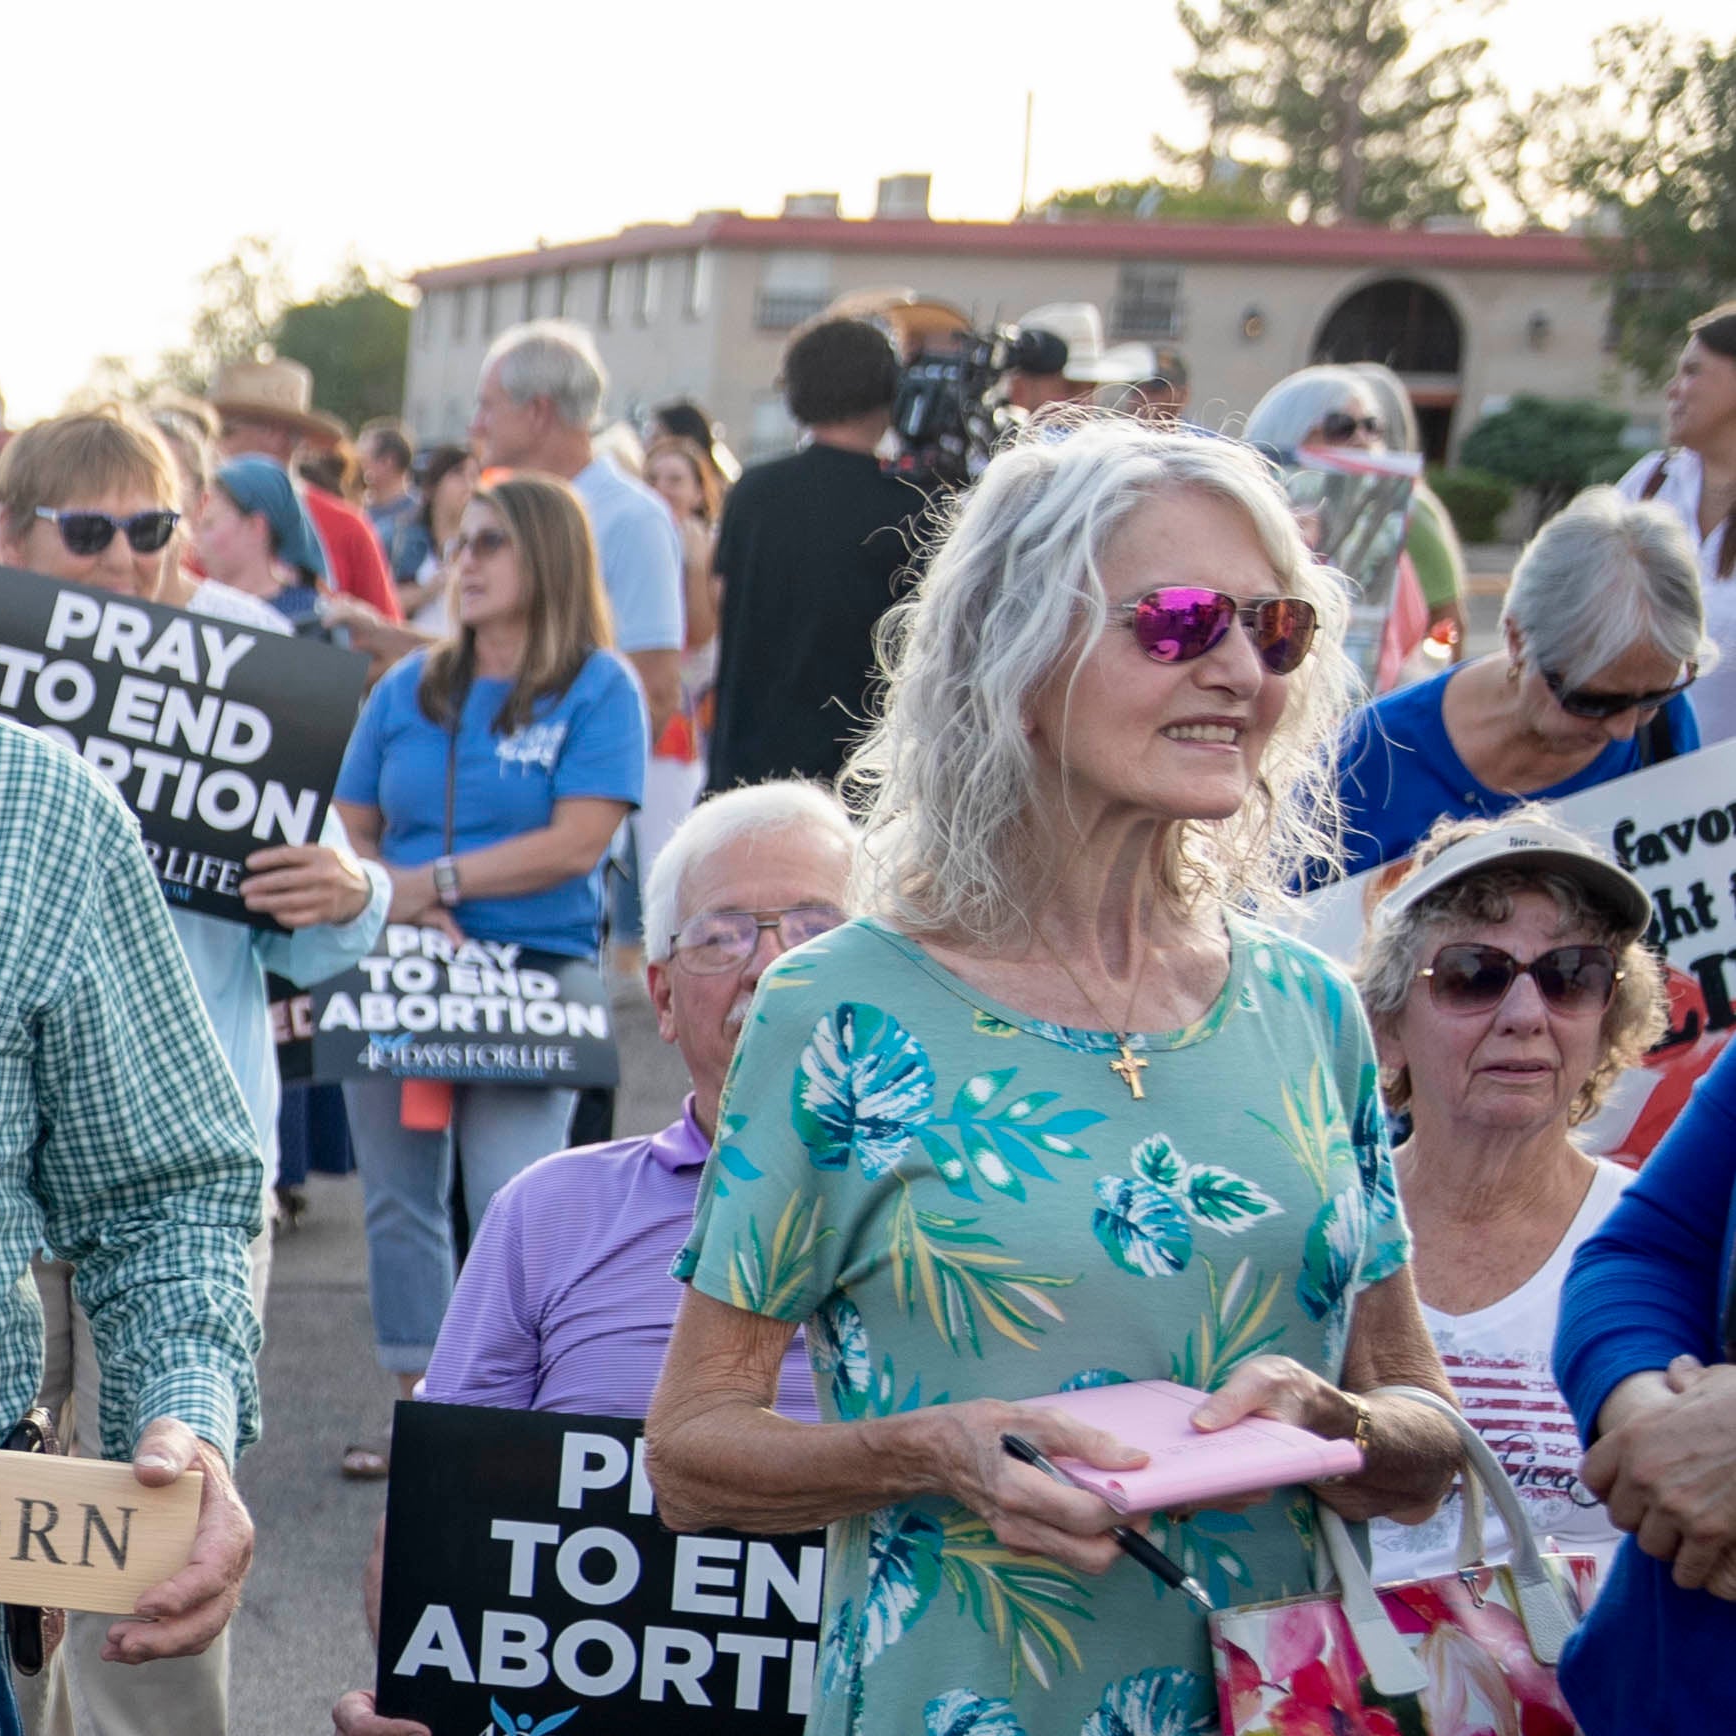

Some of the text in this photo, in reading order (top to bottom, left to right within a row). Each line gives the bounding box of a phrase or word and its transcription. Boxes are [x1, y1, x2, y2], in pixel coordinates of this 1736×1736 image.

[44, 589, 256, 691] PRAY
[107, 674, 273, 764] END
[162, 845, 243, 898] LIFE
[385, 923, 522, 972] PRAY
[357, 955, 561, 1001] TO END
[318, 991, 611, 1040] ABORTION
[517, 1045, 579, 1071] LIFE
[490, 1518, 826, 1625] TO EN
[391, 1603, 818, 1716] ABORTI
